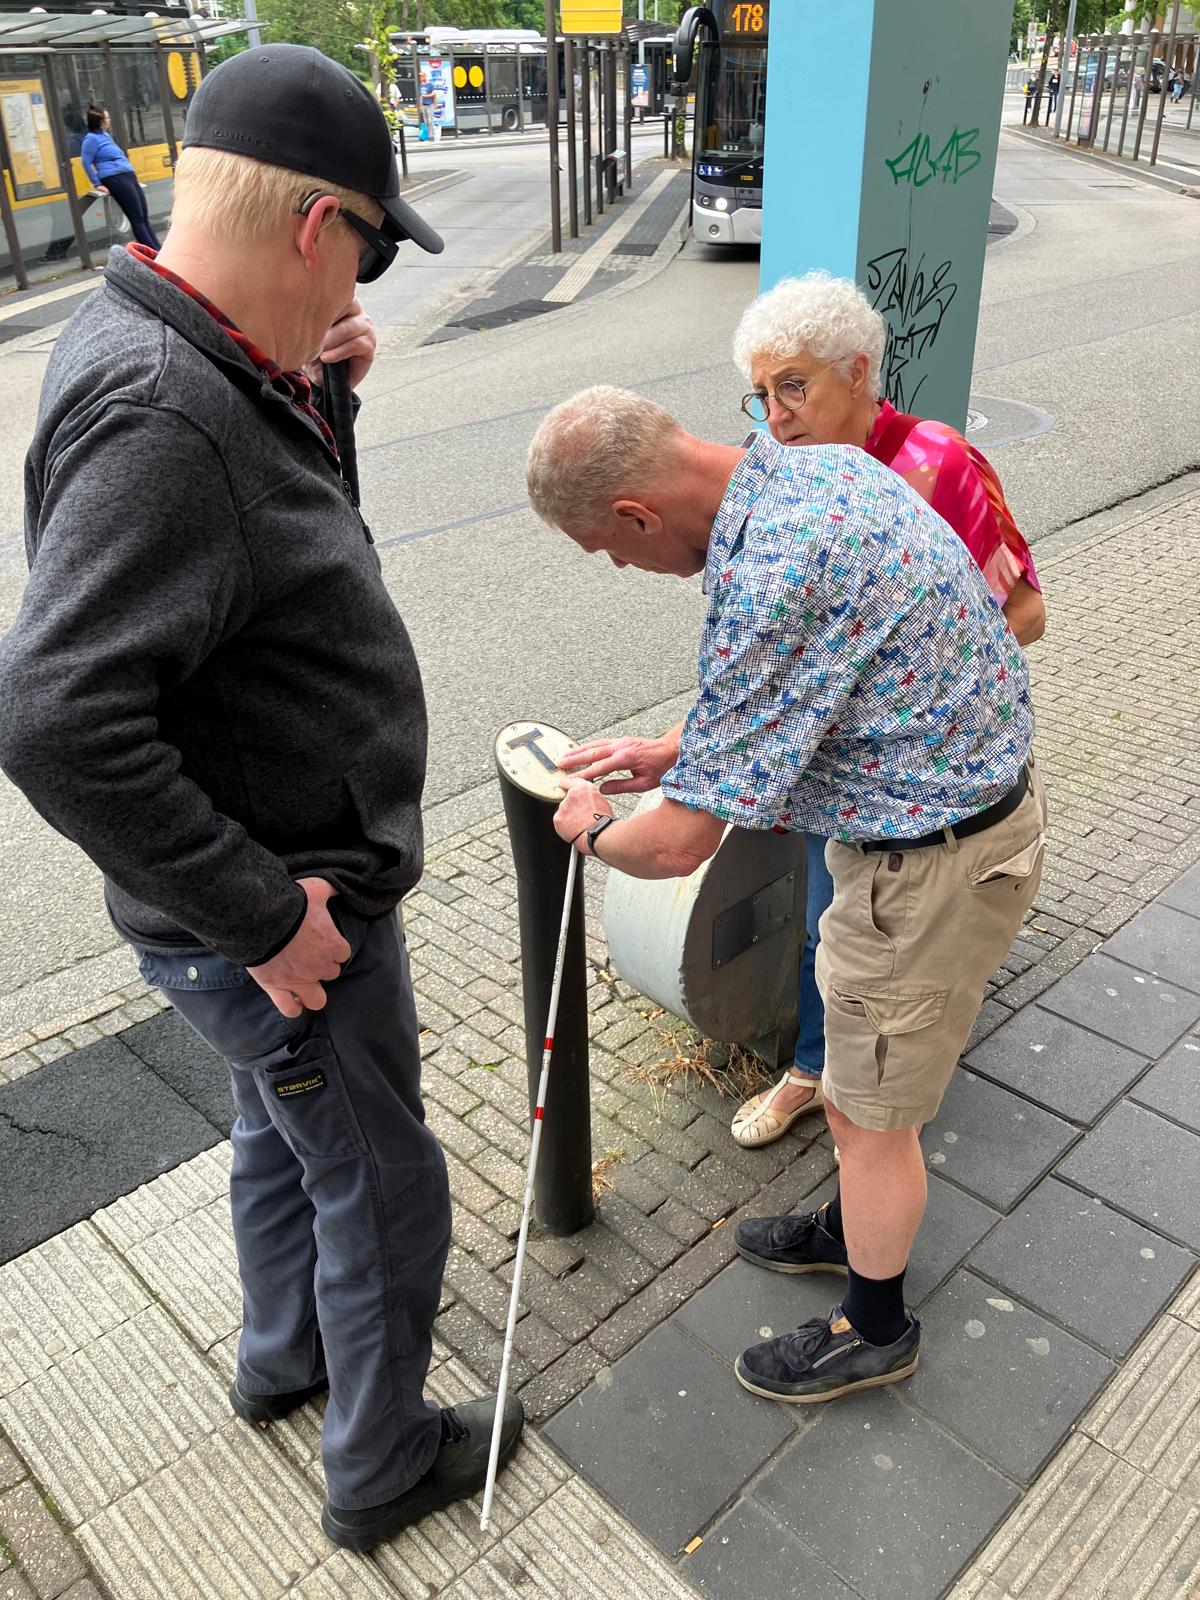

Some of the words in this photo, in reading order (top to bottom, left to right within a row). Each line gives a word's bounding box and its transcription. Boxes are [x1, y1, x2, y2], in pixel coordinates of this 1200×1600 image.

[732, 4, 764, 32] 178
[885, 127, 982, 187] ACAB
[506, 727, 559, 773] T
